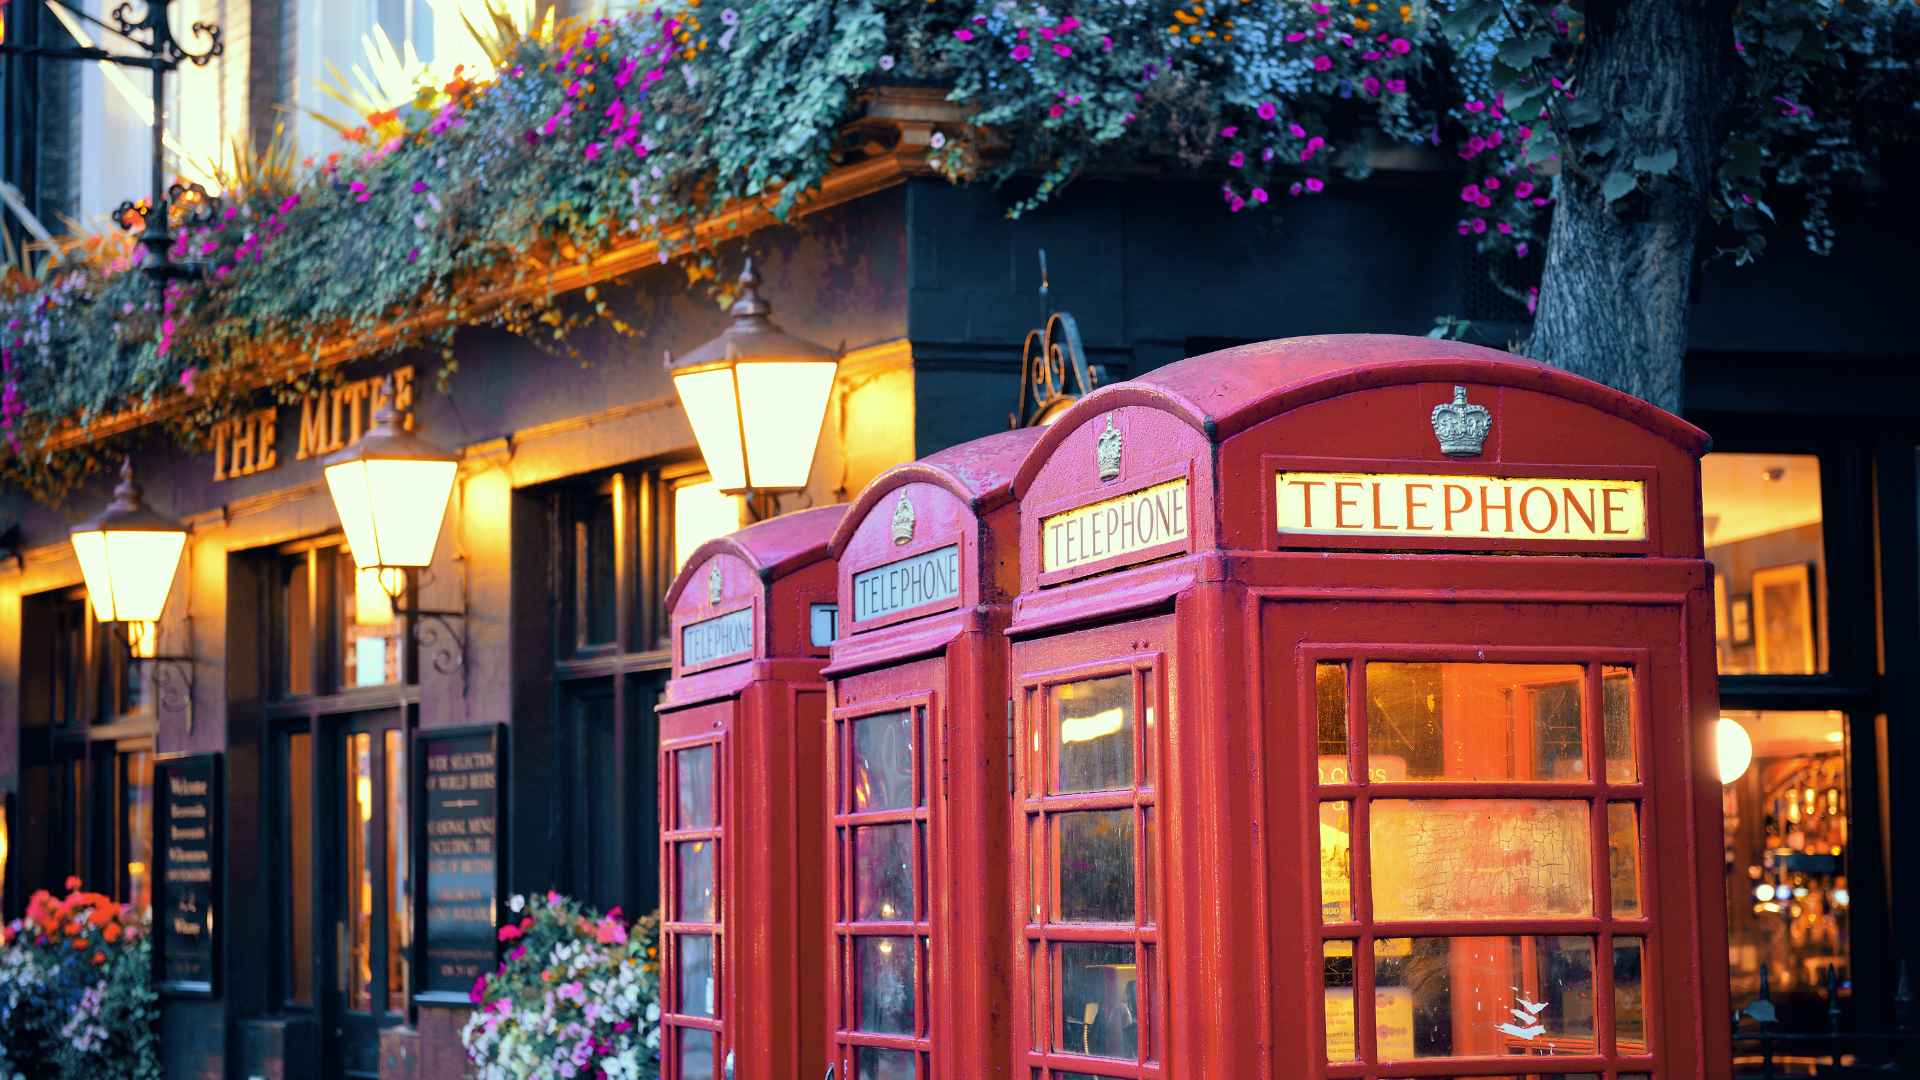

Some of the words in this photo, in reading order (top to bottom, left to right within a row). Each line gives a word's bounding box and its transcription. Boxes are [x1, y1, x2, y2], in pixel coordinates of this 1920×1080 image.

[211, 407, 276, 481] THE
[1050, 487, 1185, 566] TELEPHONE
[1286, 480, 1632, 534] TELEPHONE
[858, 552, 958, 617] TELEPHONE
[687, 617, 752, 662] TELEPHONE
